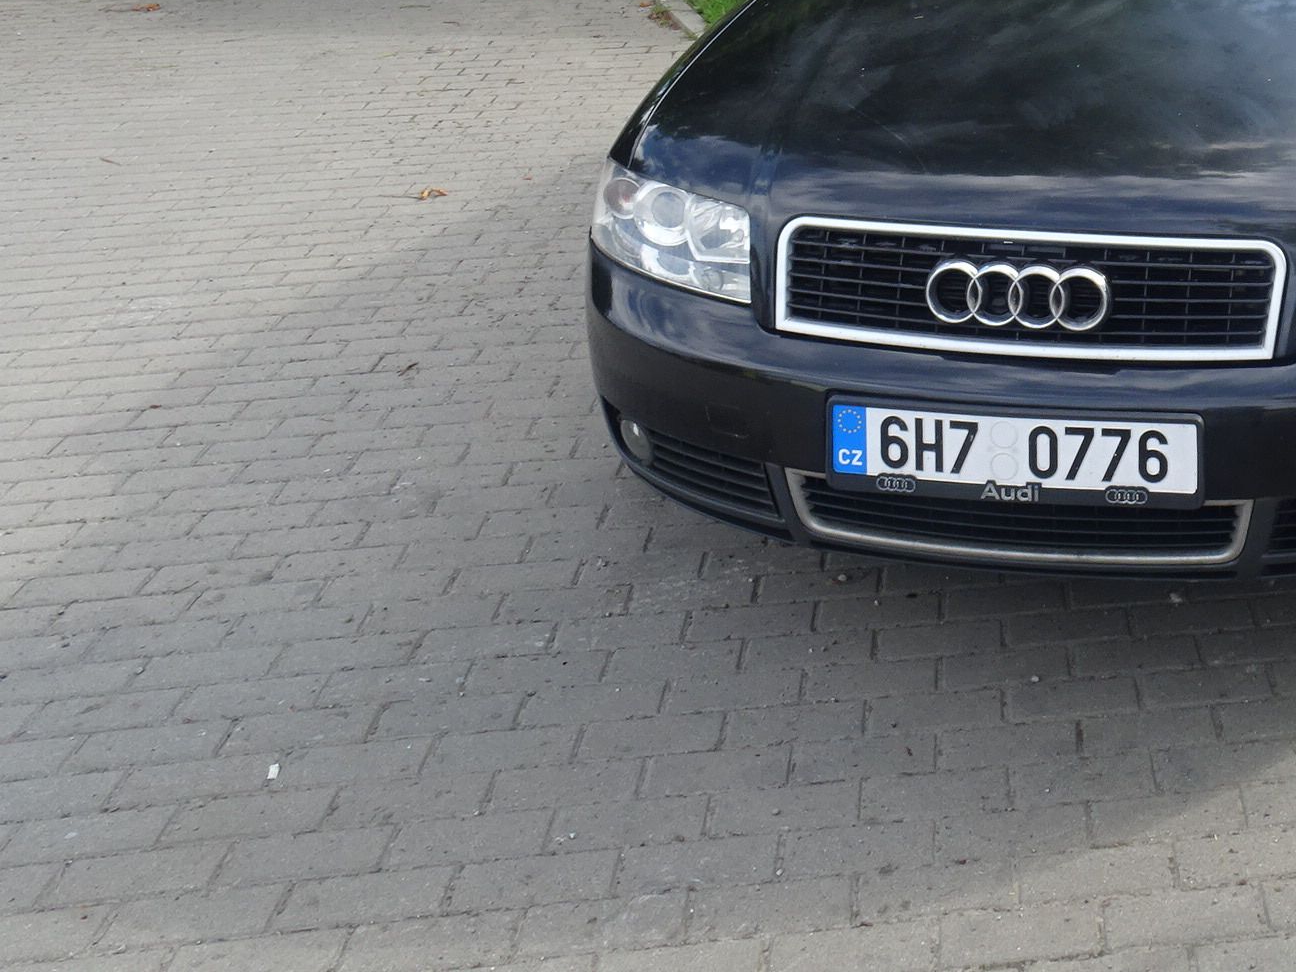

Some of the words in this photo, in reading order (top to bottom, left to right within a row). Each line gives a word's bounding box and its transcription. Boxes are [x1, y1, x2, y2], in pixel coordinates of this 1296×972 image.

[838, 448, 863, 466] CZ
[879, 415, 980, 475] 6H7
[1027, 425, 1169, 483] 0776
[980, 482, 1041, 503] Audi
